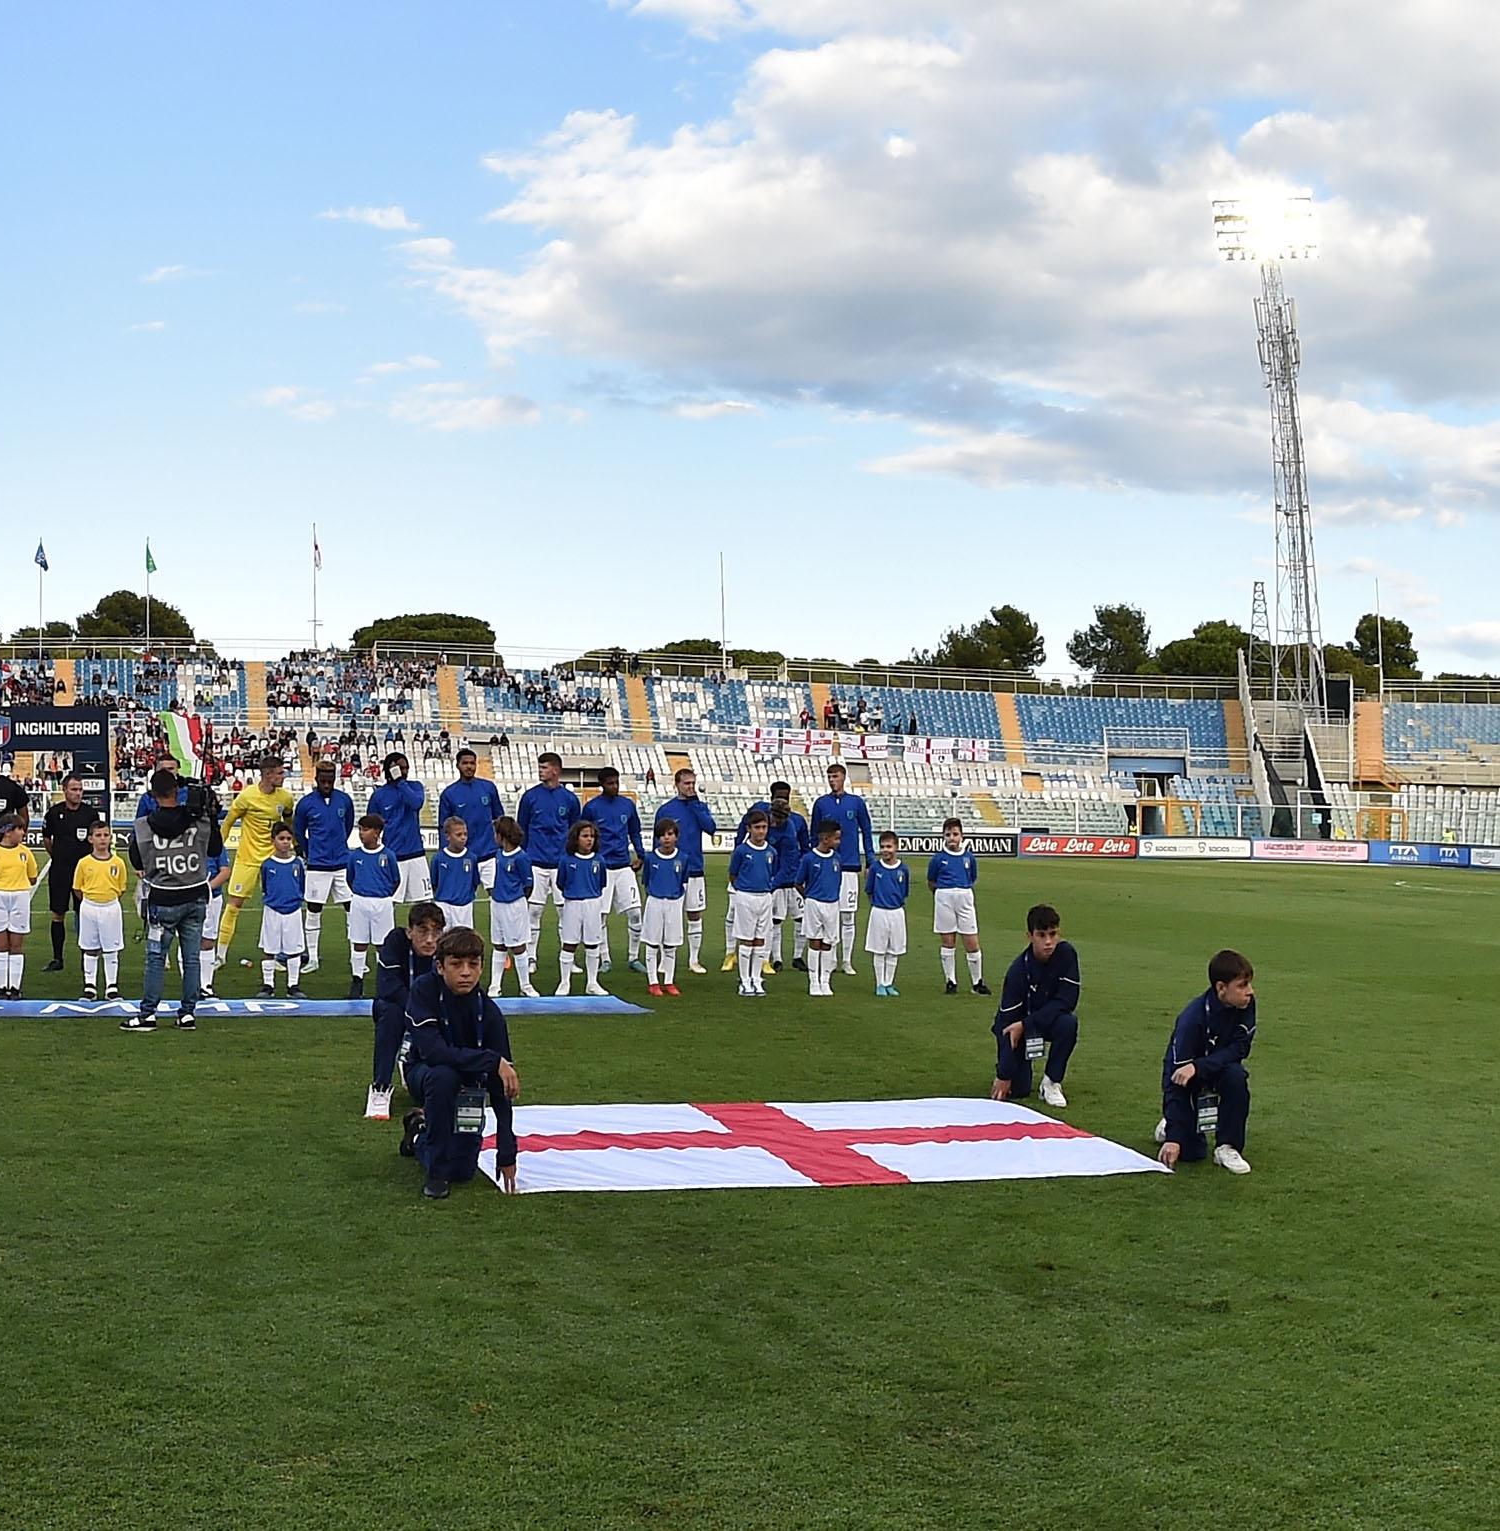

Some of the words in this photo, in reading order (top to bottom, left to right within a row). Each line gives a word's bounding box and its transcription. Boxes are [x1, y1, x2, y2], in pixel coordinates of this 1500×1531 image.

[15, 722, 100, 736] INGHILTERRA
[898, 838, 945, 851] EMPORI
[1025, 838, 1058, 851] Lete
[1062, 838, 1094, 853] Lete
[1099, 839, 1131, 853] Lete
[1389, 846, 1420, 855] ITA
[1440, 848, 1460, 858] ITA
[155, 853, 200, 874] FIGC
[630, 887, 636, 900] 7
